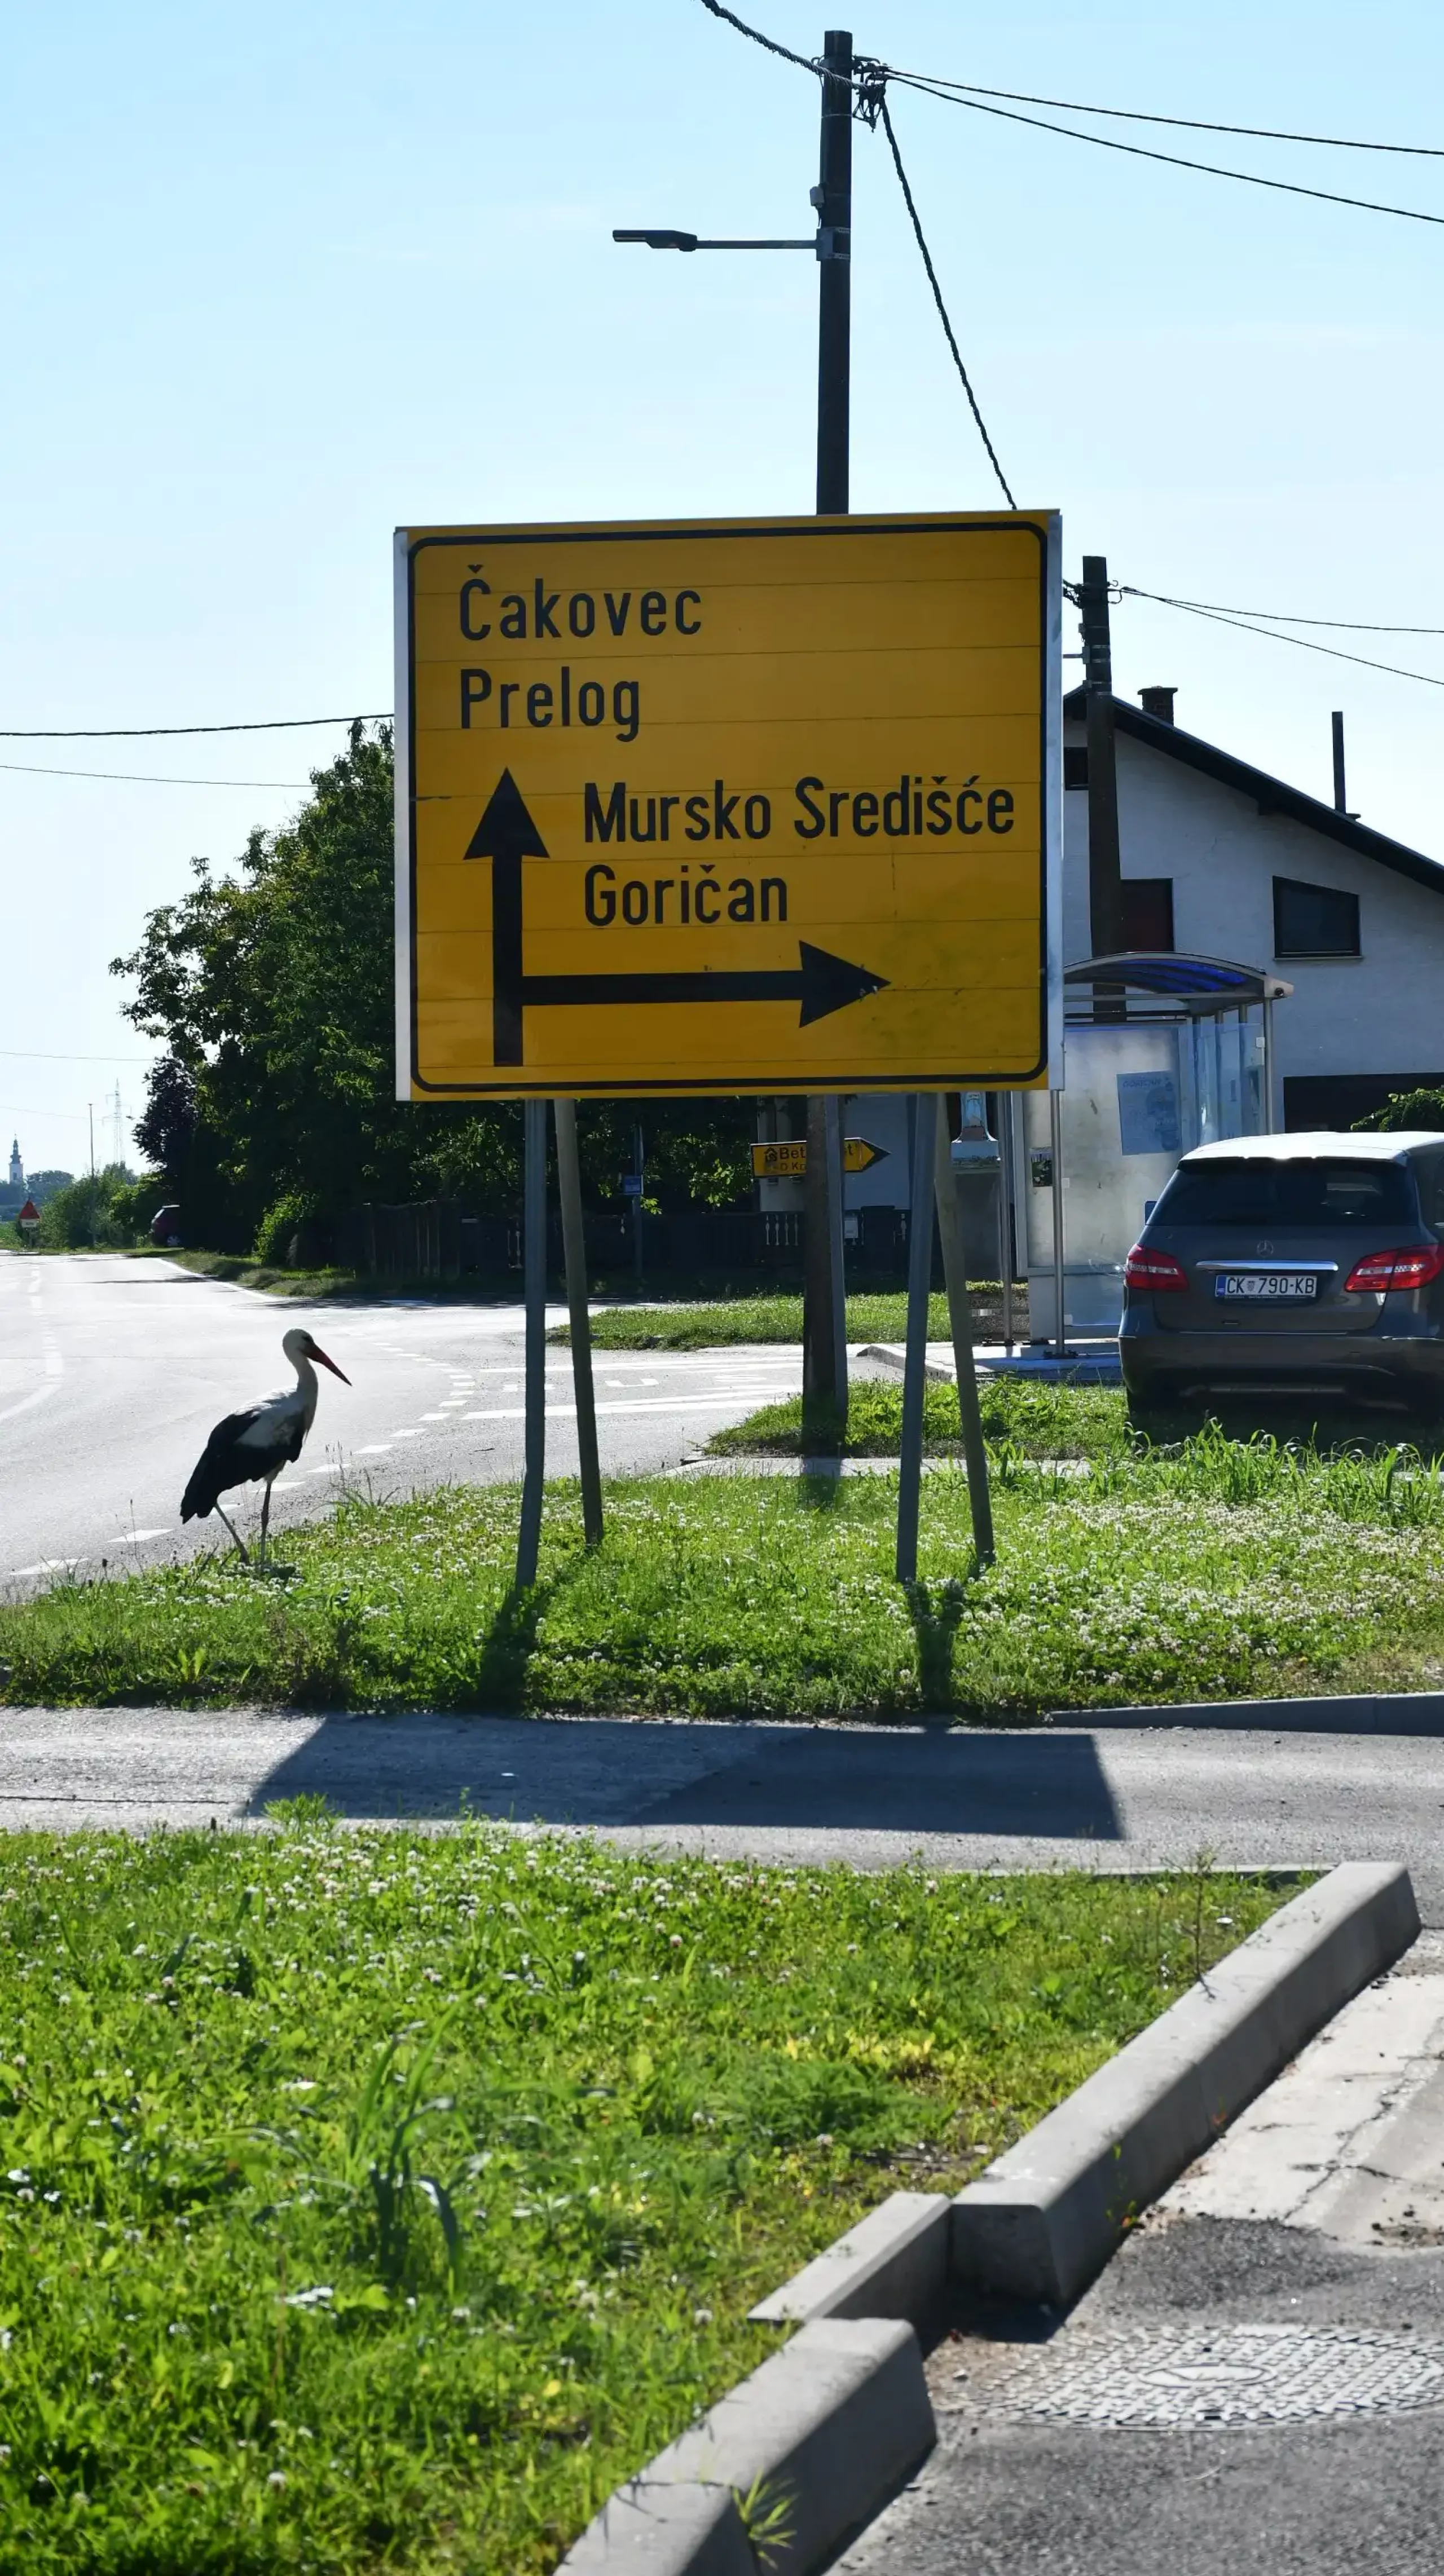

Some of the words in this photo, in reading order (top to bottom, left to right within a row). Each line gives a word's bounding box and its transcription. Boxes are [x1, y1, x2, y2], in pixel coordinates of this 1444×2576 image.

[459, 563, 703, 641] Čakovec
[459, 666, 640, 743] Prelog
[583, 779, 772, 843] Mursko
[793, 775, 1015, 839] Središće
[584, 864, 788, 927] Goričan
[1227, 1277, 1245, 1294] CK
[1258, 1277, 1314, 1294] 790-KB
